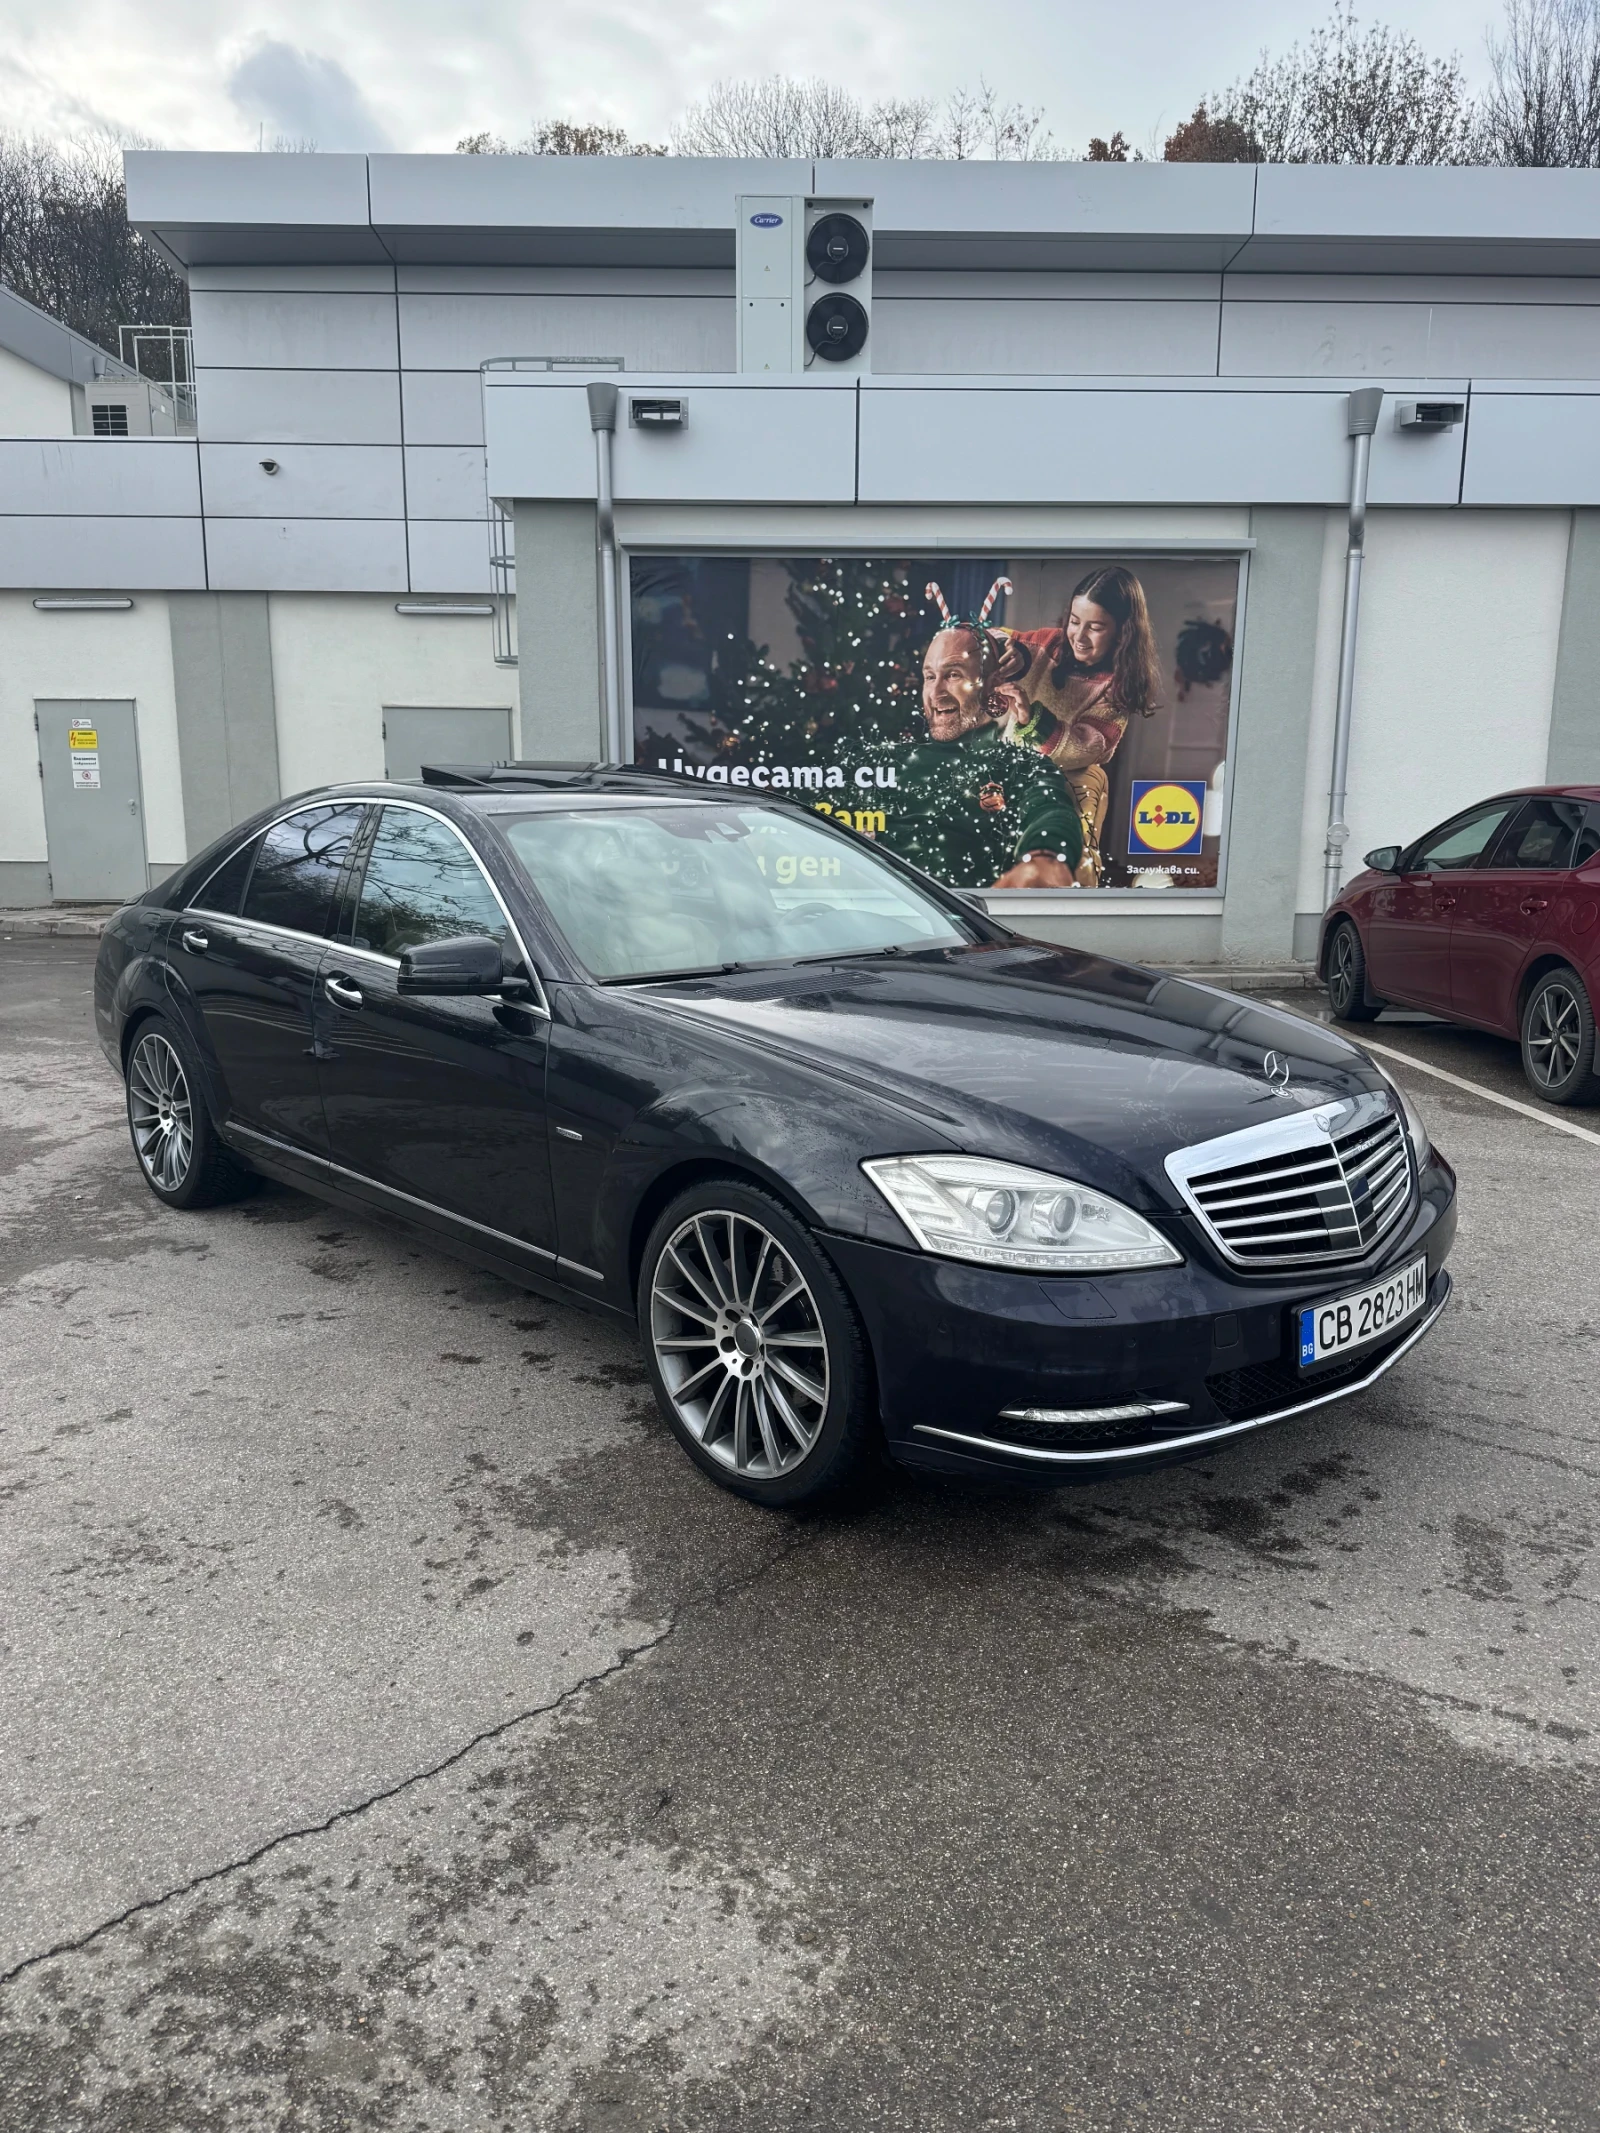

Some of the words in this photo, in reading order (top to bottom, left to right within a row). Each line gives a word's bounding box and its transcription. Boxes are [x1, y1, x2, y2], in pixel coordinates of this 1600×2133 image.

[754, 216, 779, 224] Carrier
[854, 766, 898, 789] си
[1126, 865, 1182, 875] Заслужава
[1302, 1343, 1314, 1357] BG
[1319, 1304, 1353, 1350] CB
[1358, 1279, 1404, 1338] 2823
[1406, 1262, 1424, 1311] HM
